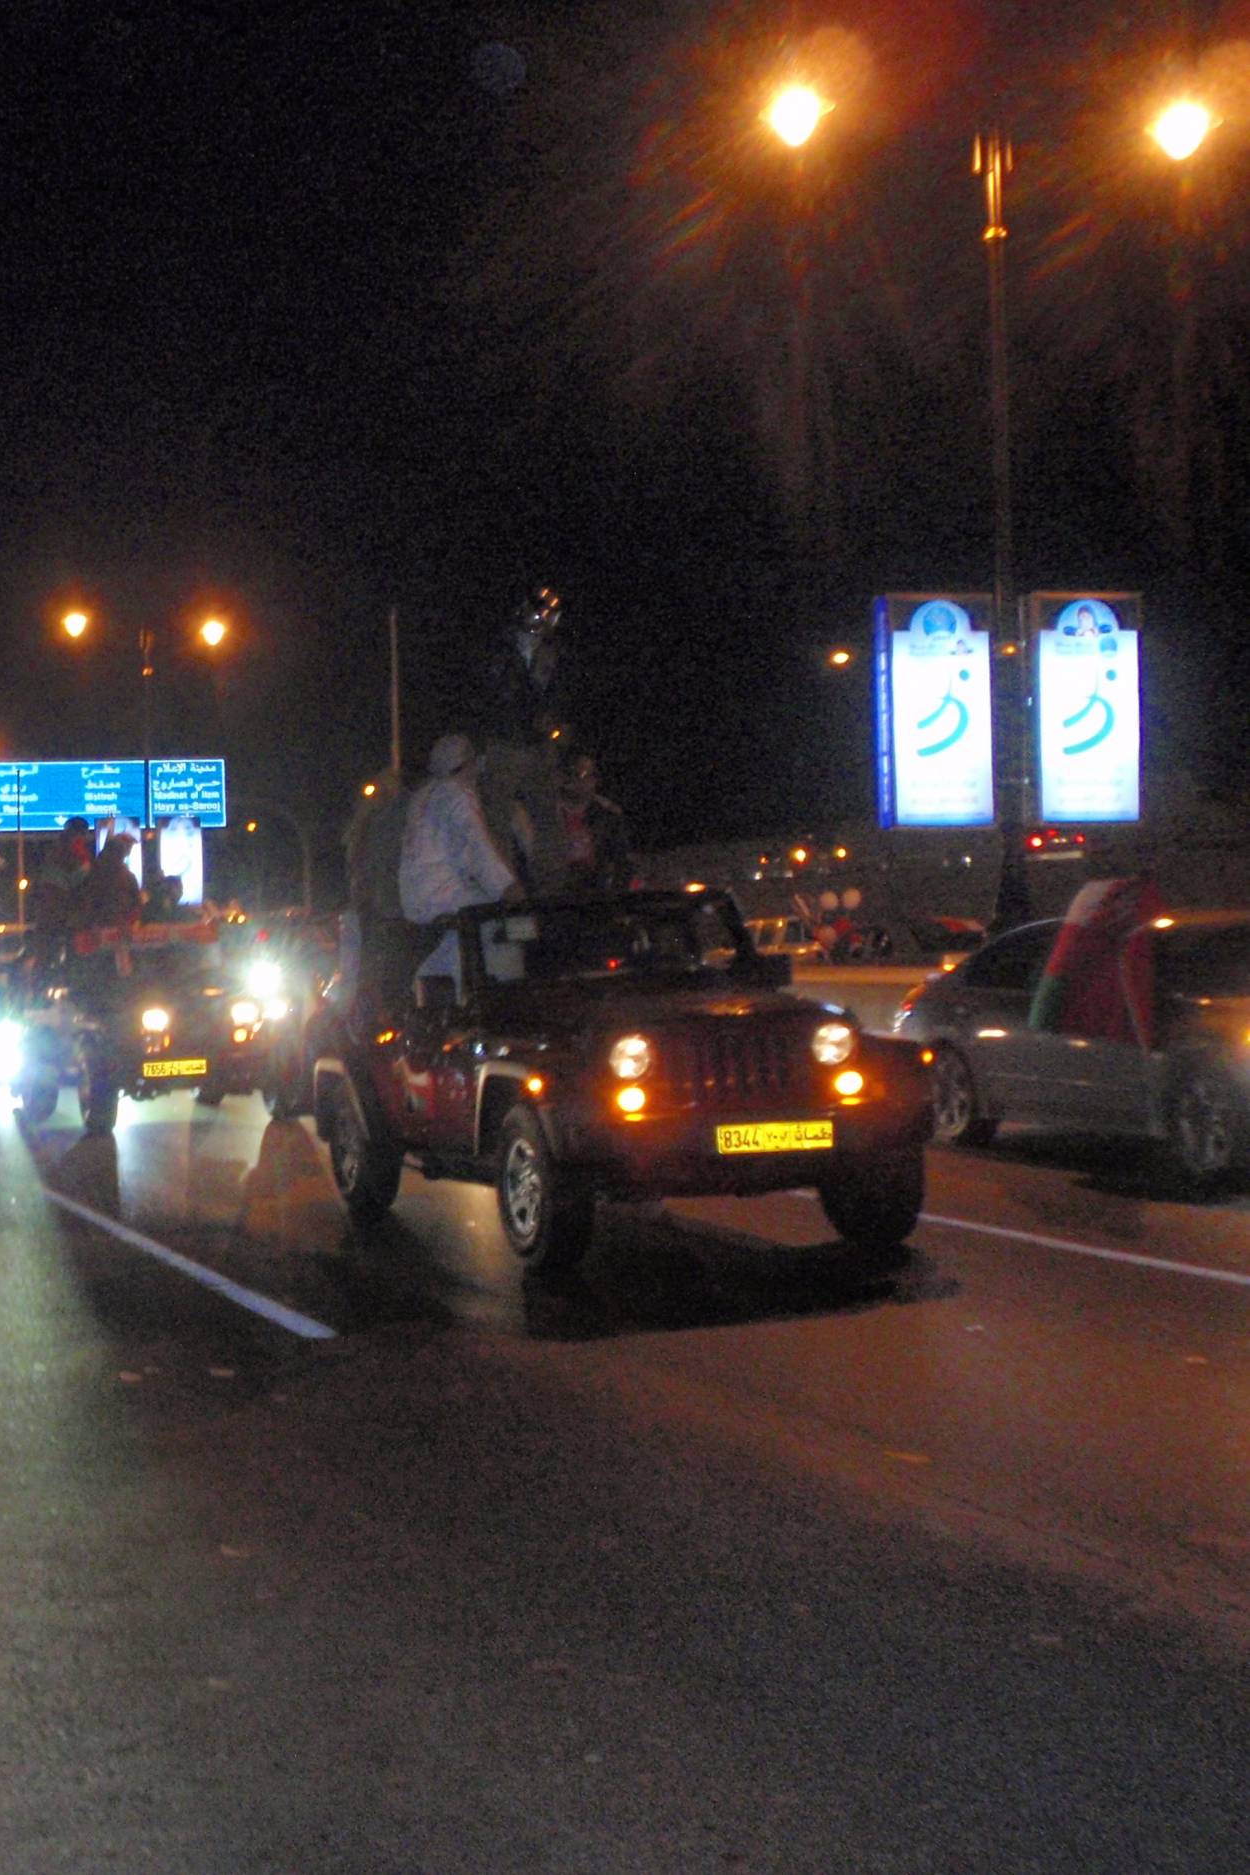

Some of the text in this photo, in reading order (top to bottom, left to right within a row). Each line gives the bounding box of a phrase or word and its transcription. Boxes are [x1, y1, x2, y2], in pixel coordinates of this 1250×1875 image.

[190, 763, 217, 774] مدينة
[195, 780, 222, 792] حي
[723, 1129, 760, 1150] 8344
